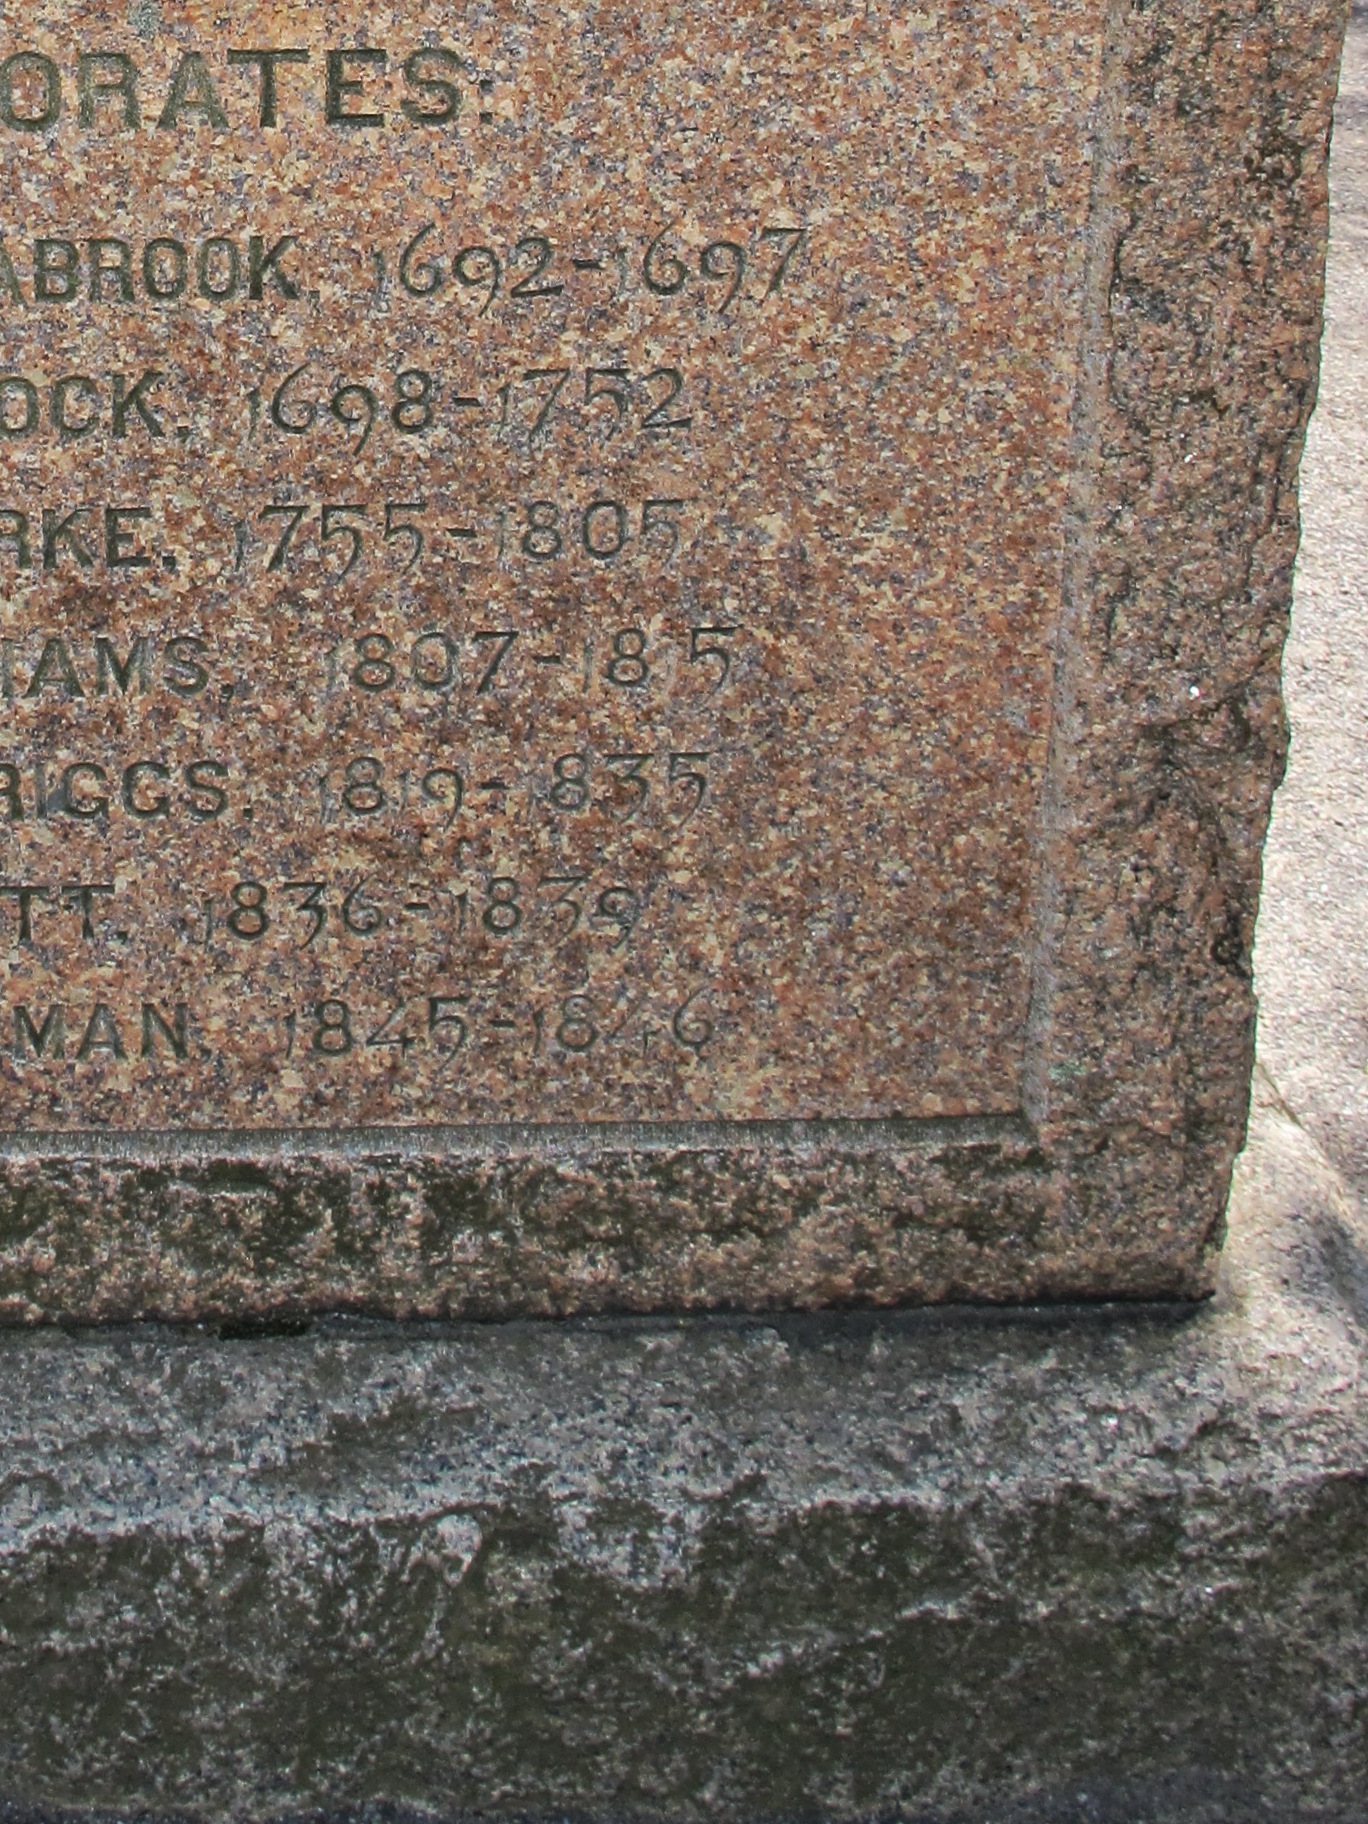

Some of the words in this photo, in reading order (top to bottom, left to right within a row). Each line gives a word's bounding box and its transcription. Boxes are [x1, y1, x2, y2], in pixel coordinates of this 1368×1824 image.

[370, 221, 808, 314] 1692-1697
[247, 362, 694, 456] 1698-1752
[233, 498, 694, 576] 1755-1805
[201, 878, 634, 952] 1836-1839
[285, 988, 714, 1069] 1845-1846
